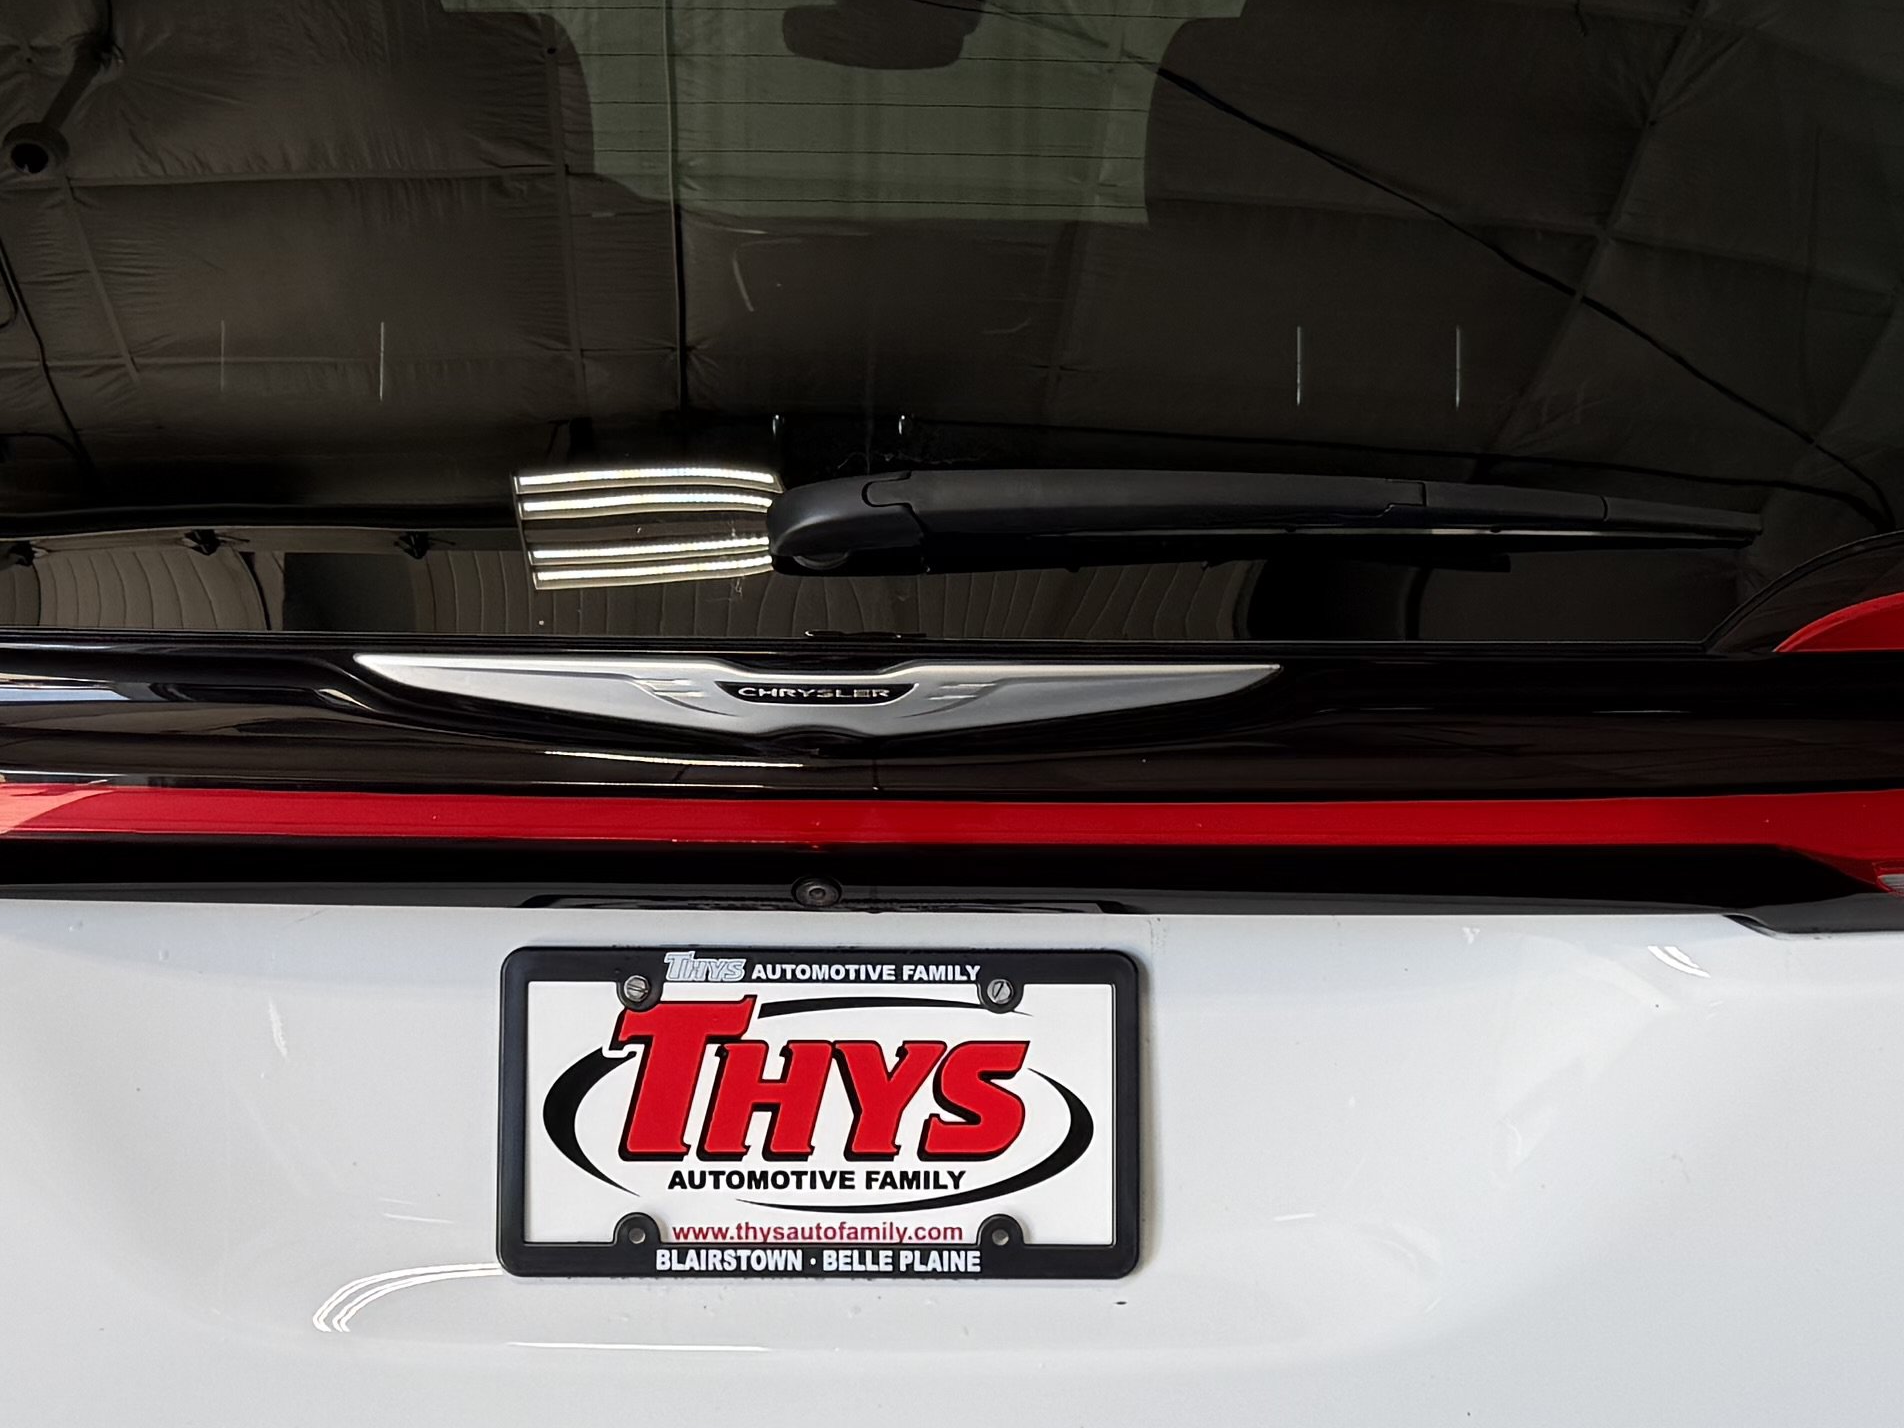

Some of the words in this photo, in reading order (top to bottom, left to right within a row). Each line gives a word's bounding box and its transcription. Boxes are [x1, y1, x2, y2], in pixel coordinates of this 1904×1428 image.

[738, 686, 891, 698] CHRYSLER
[663, 950, 747, 983] THYS
[751, 962, 895, 982] AUTOMOTIVE
[902, 963, 981, 983] FAMILY
[612, 994, 1031, 1163] THYS
[667, 1169, 856, 1191] AUTOMOTIVE
[864, 1170, 967, 1191] FAMILY
[671, 1221, 964, 1245] www.thysautofamily.com
[655, 1248, 802, 1272] BLAIRSTOWN
[823, 1250, 893, 1273] BELLE
[900, 1251, 981, 1273] PLAINE
